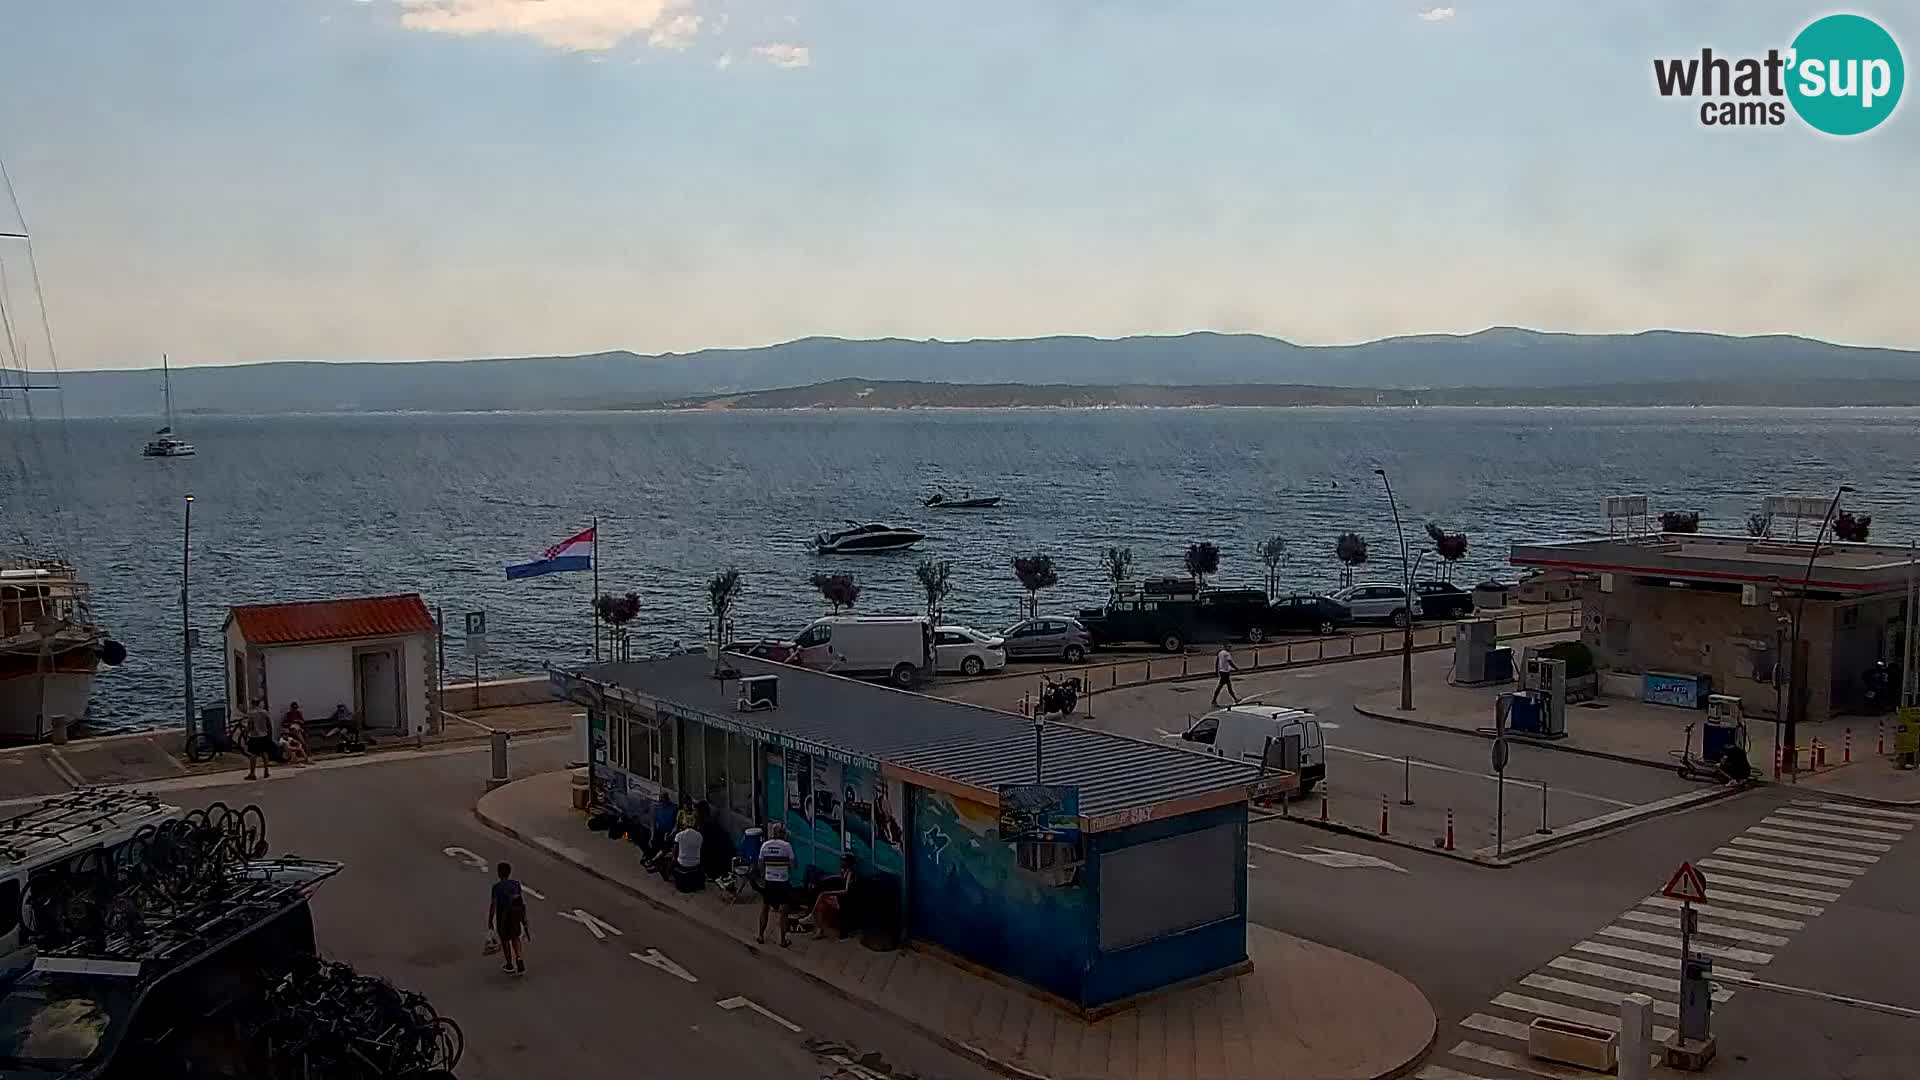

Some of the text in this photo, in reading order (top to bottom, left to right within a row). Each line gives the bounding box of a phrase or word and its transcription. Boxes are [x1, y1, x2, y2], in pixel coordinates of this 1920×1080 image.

[470, 615, 480, 632] P
[780, 736, 794, 749] BUS
[795, 740, 825, 757] STATION
[828, 750, 851, 764] TICKET
[853, 756, 880, 771] OFFICE
